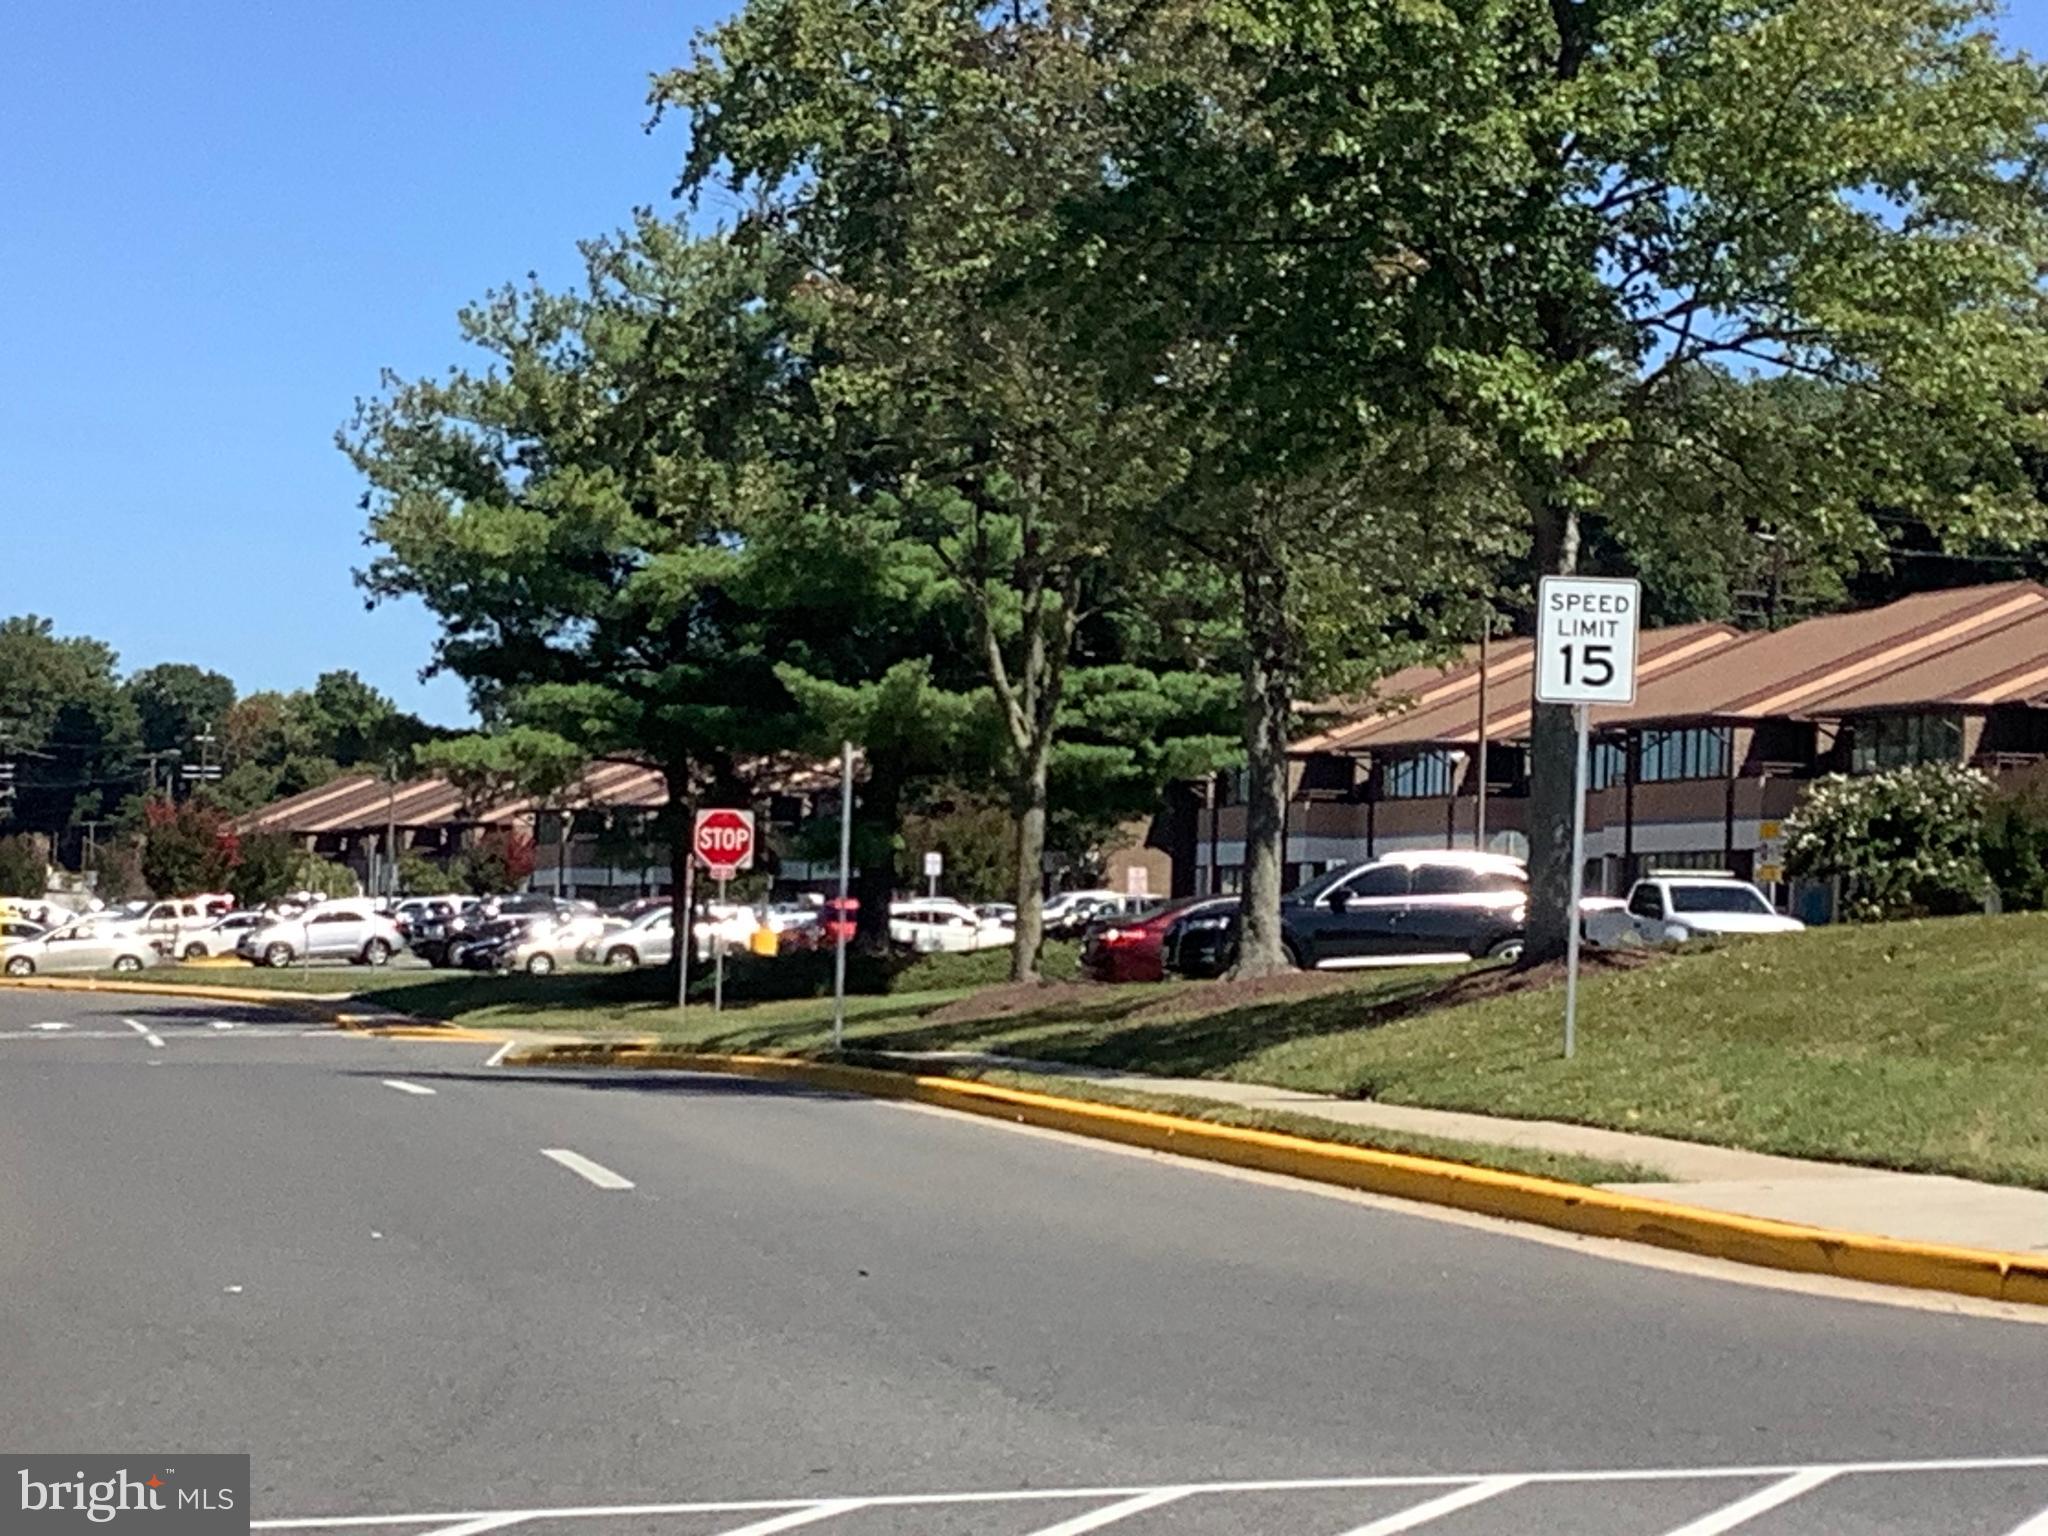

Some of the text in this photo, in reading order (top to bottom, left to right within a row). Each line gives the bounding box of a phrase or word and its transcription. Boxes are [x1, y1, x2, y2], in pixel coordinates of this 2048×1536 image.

[1550, 593, 1629, 613] SPEED
[1558, 619, 1618, 638] LIMIT
[1559, 643, 1614, 687] 15
[700, 827, 749, 851] STOP
